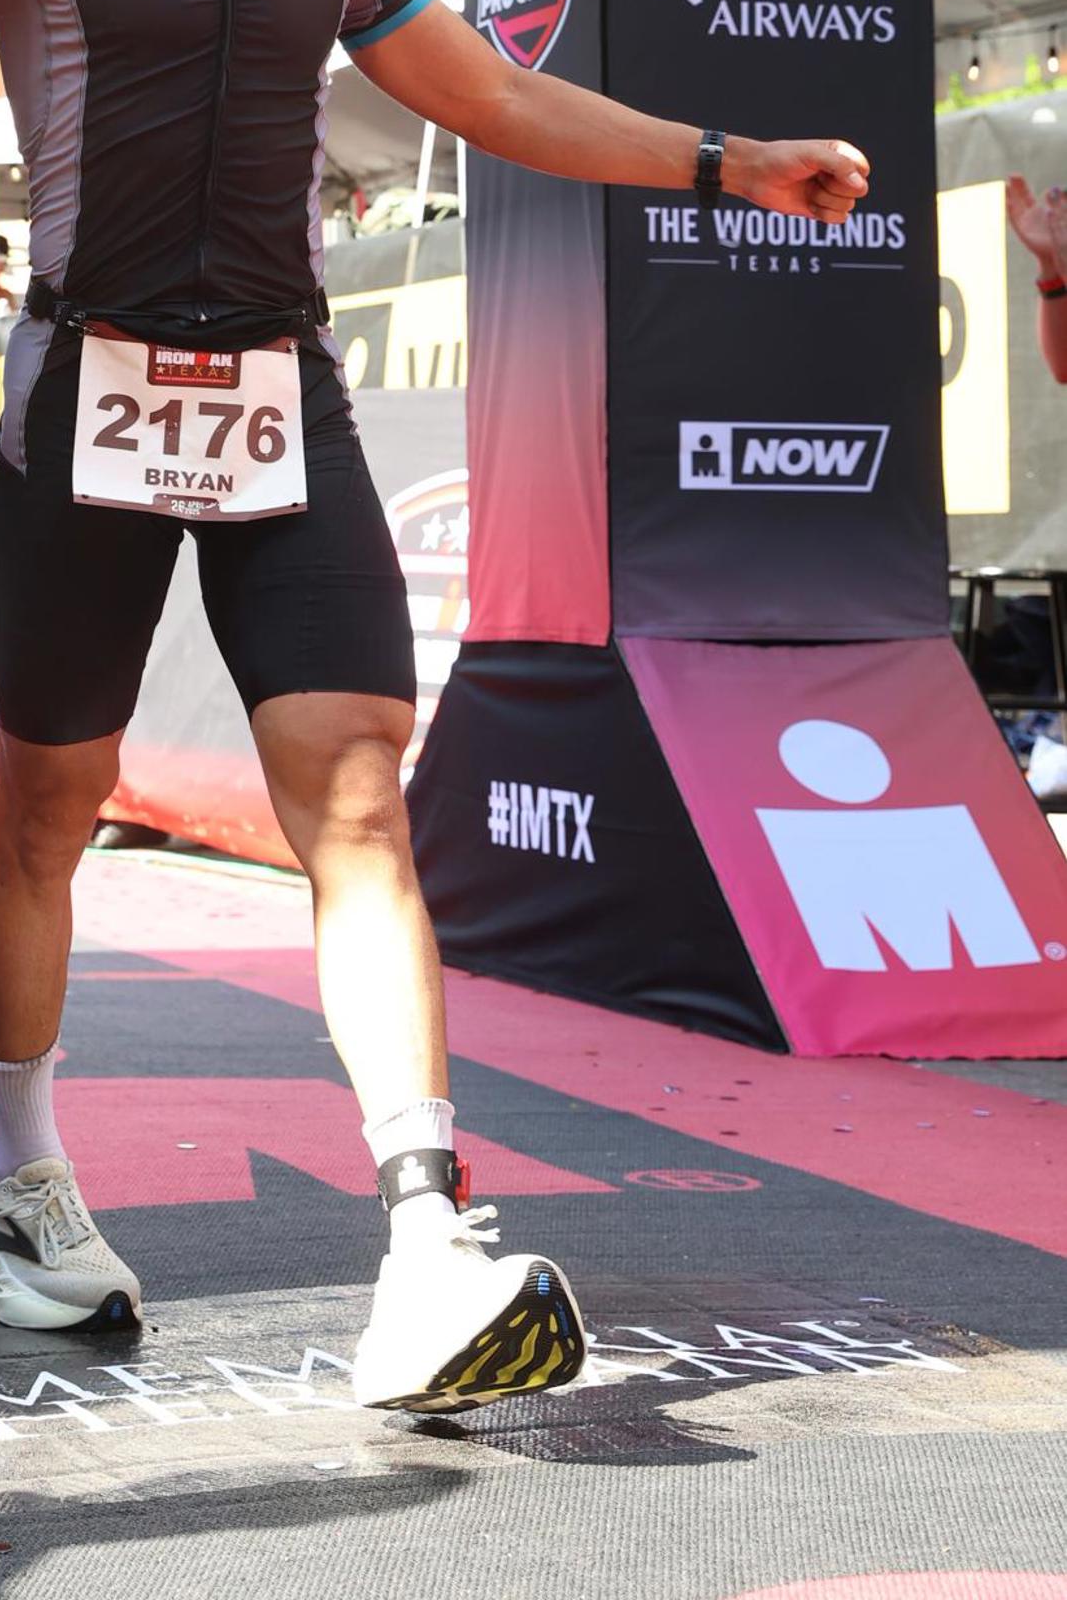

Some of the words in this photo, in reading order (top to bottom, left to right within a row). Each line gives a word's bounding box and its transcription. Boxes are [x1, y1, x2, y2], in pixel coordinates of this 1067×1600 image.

[709, 0, 896, 43] AIRWAYS
[645, 207, 700, 244] THE
[714, 208, 906, 249] WOODLANDS
[729, 255, 822, 274] TEXAS
[168, 365, 231, 378] TEXAS
[93, 393, 286, 464] 2176
[741, 437, 867, 476] NOW
[145, 468, 233, 493] BRYAN
[488, 780, 595, 864] #IMTX
